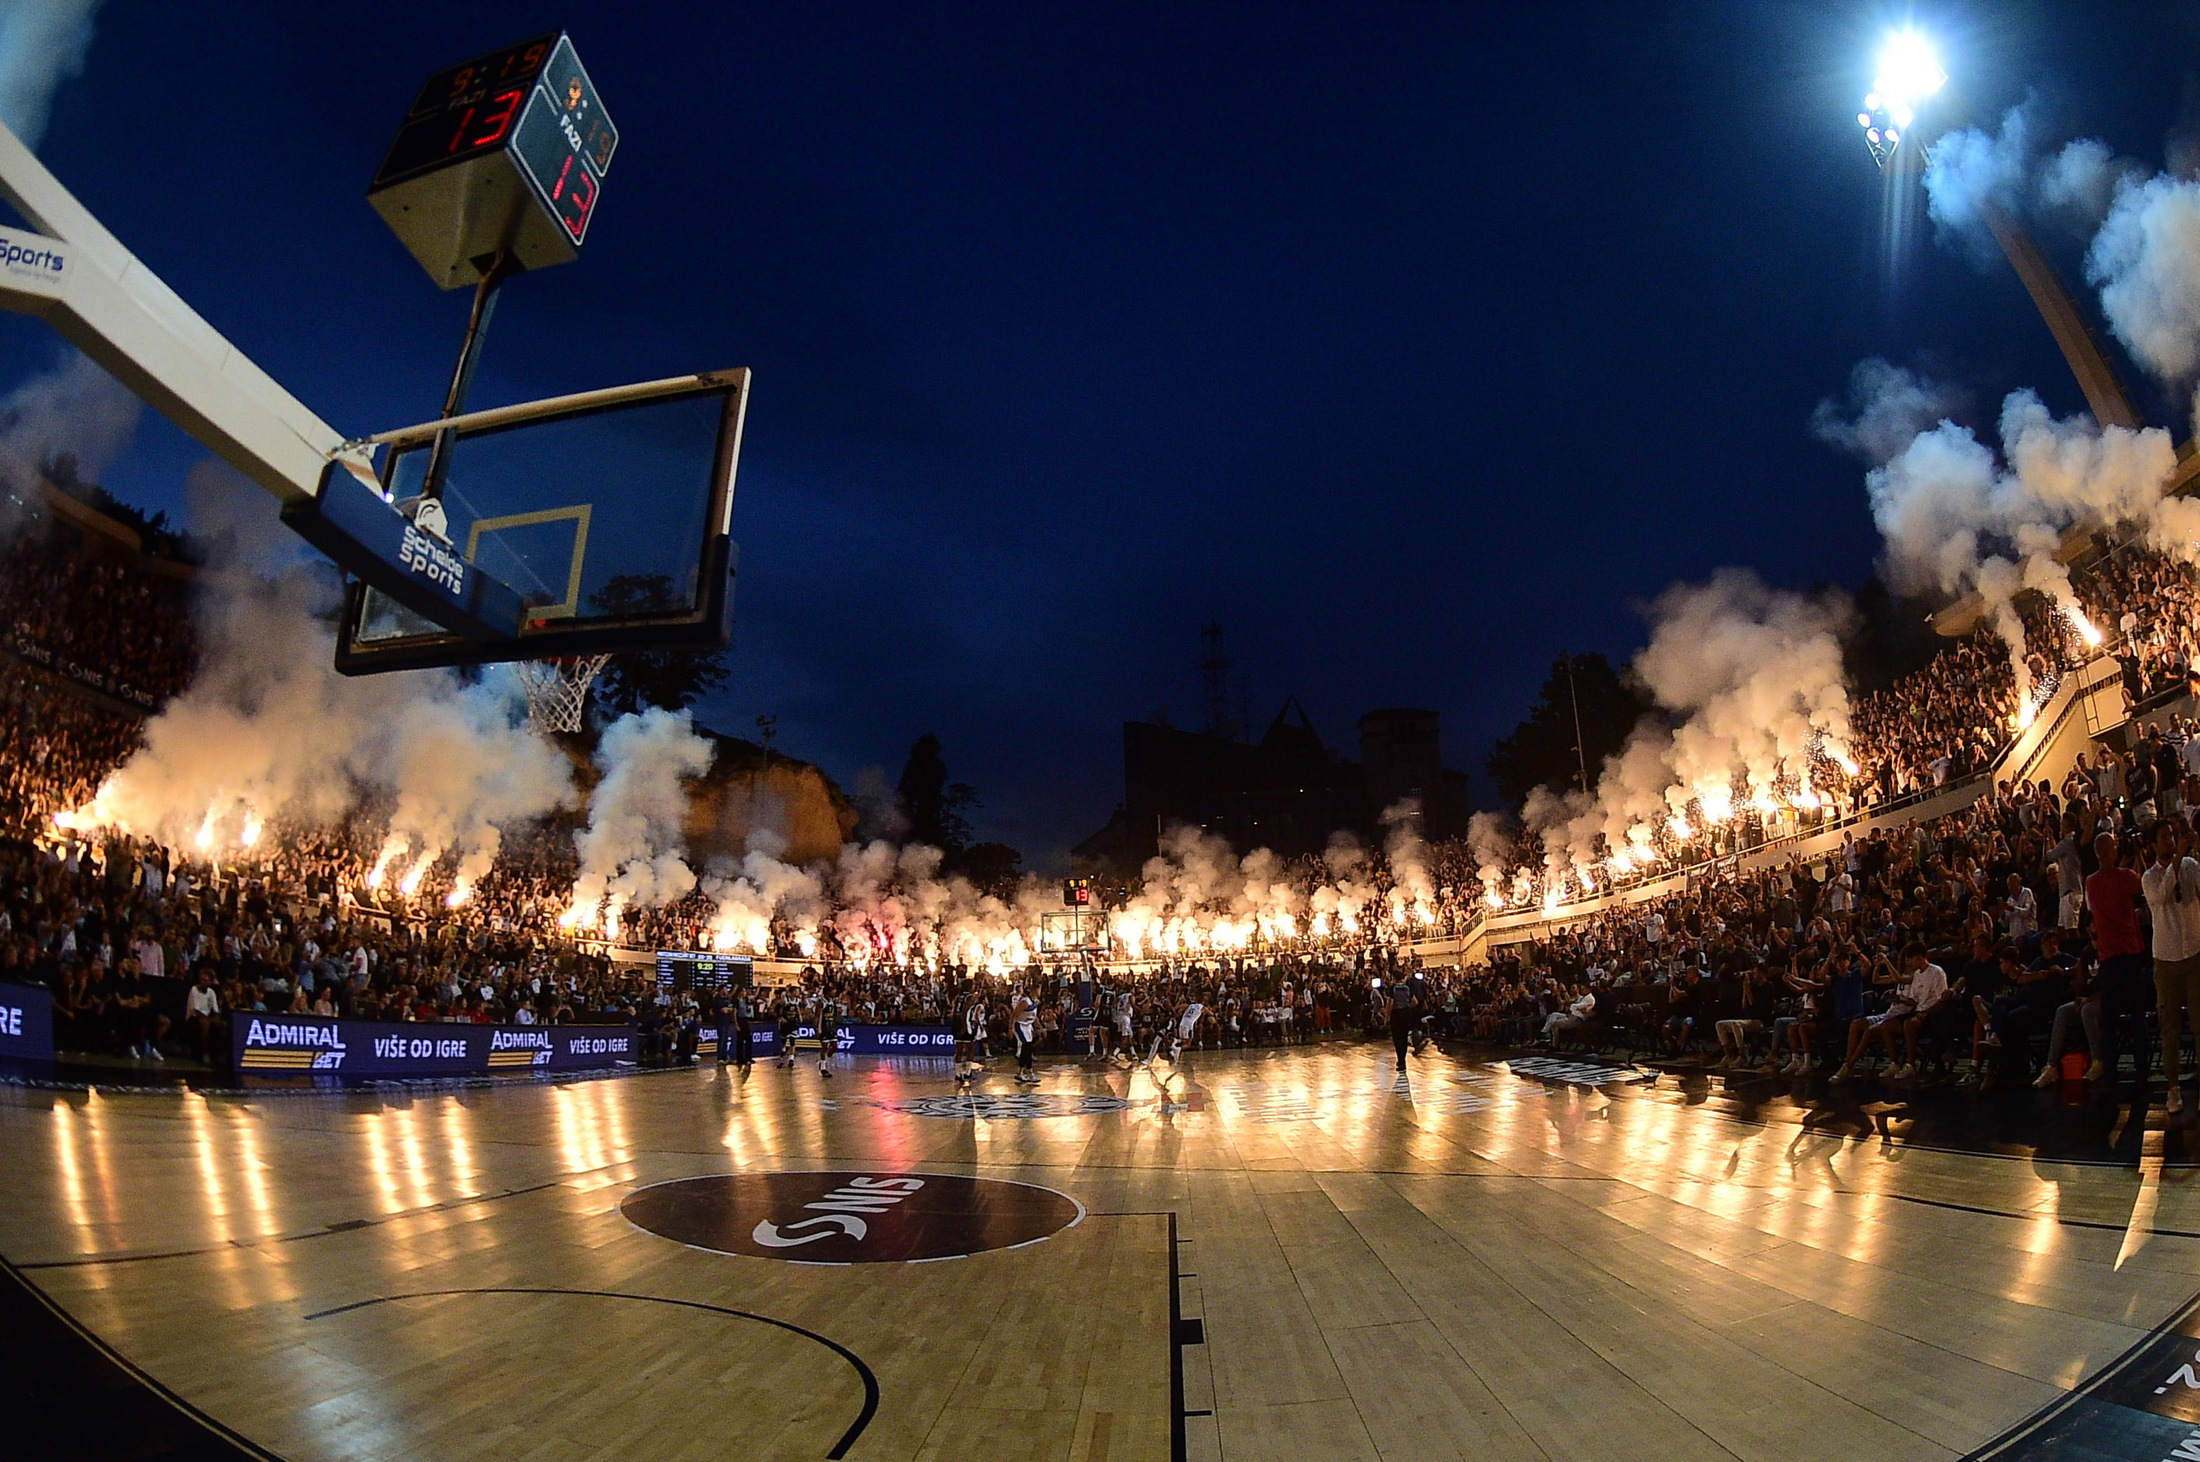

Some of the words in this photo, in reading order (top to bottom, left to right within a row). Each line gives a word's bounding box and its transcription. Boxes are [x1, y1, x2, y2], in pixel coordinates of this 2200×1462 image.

[450, 90, 523, 152] 13
[560, 114, 583, 152] FAZI
[553, 154, 596, 236] 13
[399, 543, 462, 595] Sports
[1075, 889, 1088, 901] 13
[246, 1019, 346, 1049] ADMIRAL
[490, 1030, 553, 1050] ADMIRAL
[877, 1031, 905, 1045] VIŠE
[908, 1034, 928, 1045] OD
[931, 1034, 955, 1045] IGR
[374, 1034, 407, 1058] VIŠE
[410, 1039, 431, 1058] OD
[436, 1040, 467, 1057] IGRE
[569, 1036, 591, 1055] VIŠE
[592, 1039, 606, 1053] OD
[608, 1038, 628, 1052] IGRE
[312, 1051, 346, 1069] BET
[532, 1051, 553, 1065] BET
